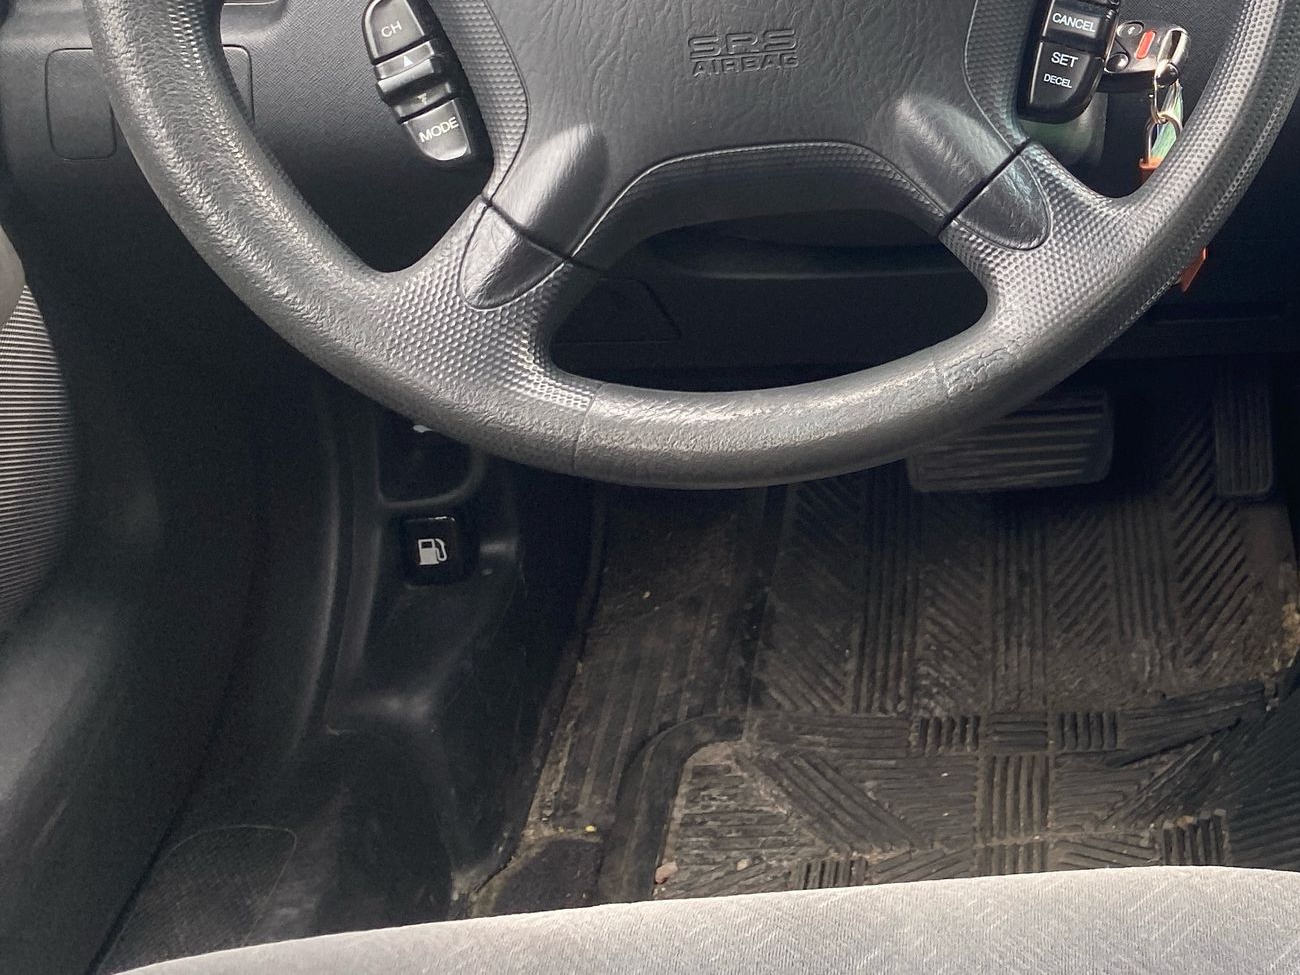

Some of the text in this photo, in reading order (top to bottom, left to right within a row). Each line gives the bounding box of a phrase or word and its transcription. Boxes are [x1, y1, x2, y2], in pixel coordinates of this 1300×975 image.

[381, 20, 403, 38] CH
[1052, 12, 1097, 33] CANCEL
[687, 29, 797, 59] SRS
[692, 52, 799, 77] AIRBAG
[1051, 51, 1079, 68] SET
[1043, 73, 1073, 89] DECEL
[418, 116, 460, 143] MODE
